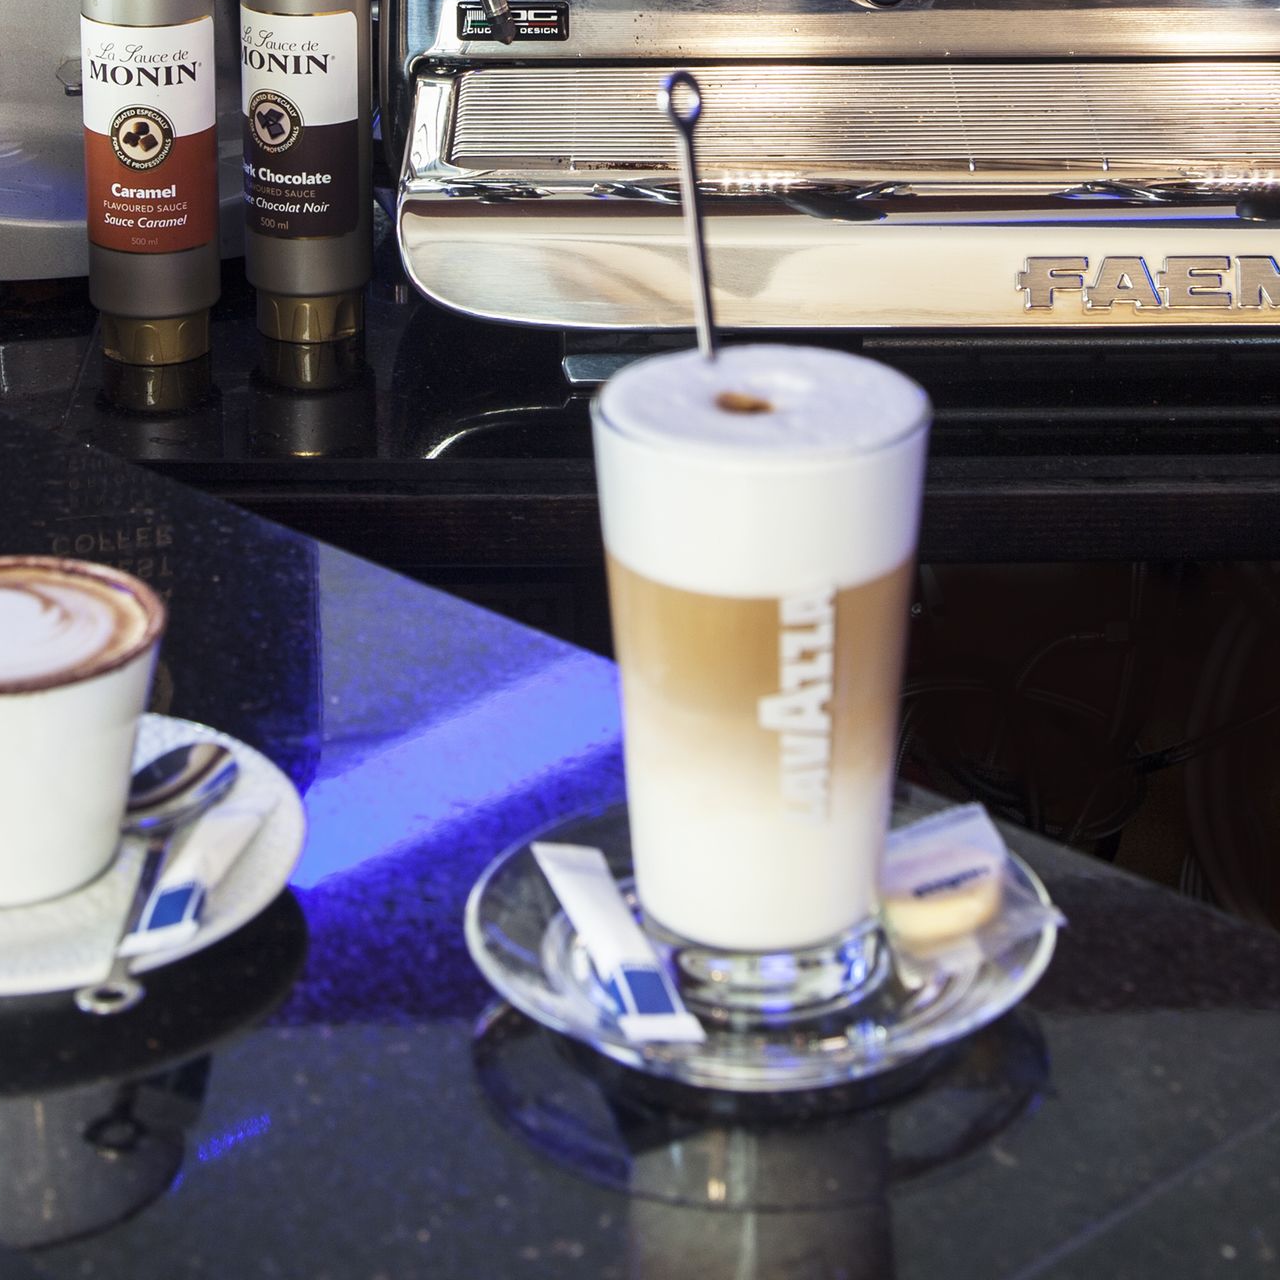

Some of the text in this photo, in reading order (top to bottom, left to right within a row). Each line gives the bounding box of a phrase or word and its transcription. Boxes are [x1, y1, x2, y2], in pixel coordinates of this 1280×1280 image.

[254, 29, 297, 52] Sauce
[301, 40, 319, 52] de
[95, 42, 189, 63] La Sauce de
[89, 59, 198, 87] MONIN
[114, 108, 169, 129] CREATED ESPECIALLY
[258, 167, 332, 185] Chocolate
[111, 182, 176, 199] Caramel
[285, 189, 316, 198] SAUCE
[103, 200, 188, 213] FLAVOURED SAUCE
[256, 197, 300, 213] Chocolat
[303, 202, 330, 213] Noir
[104, 212, 188, 228] Sauce Caramel
[260, 216, 289, 230] 500 ml
